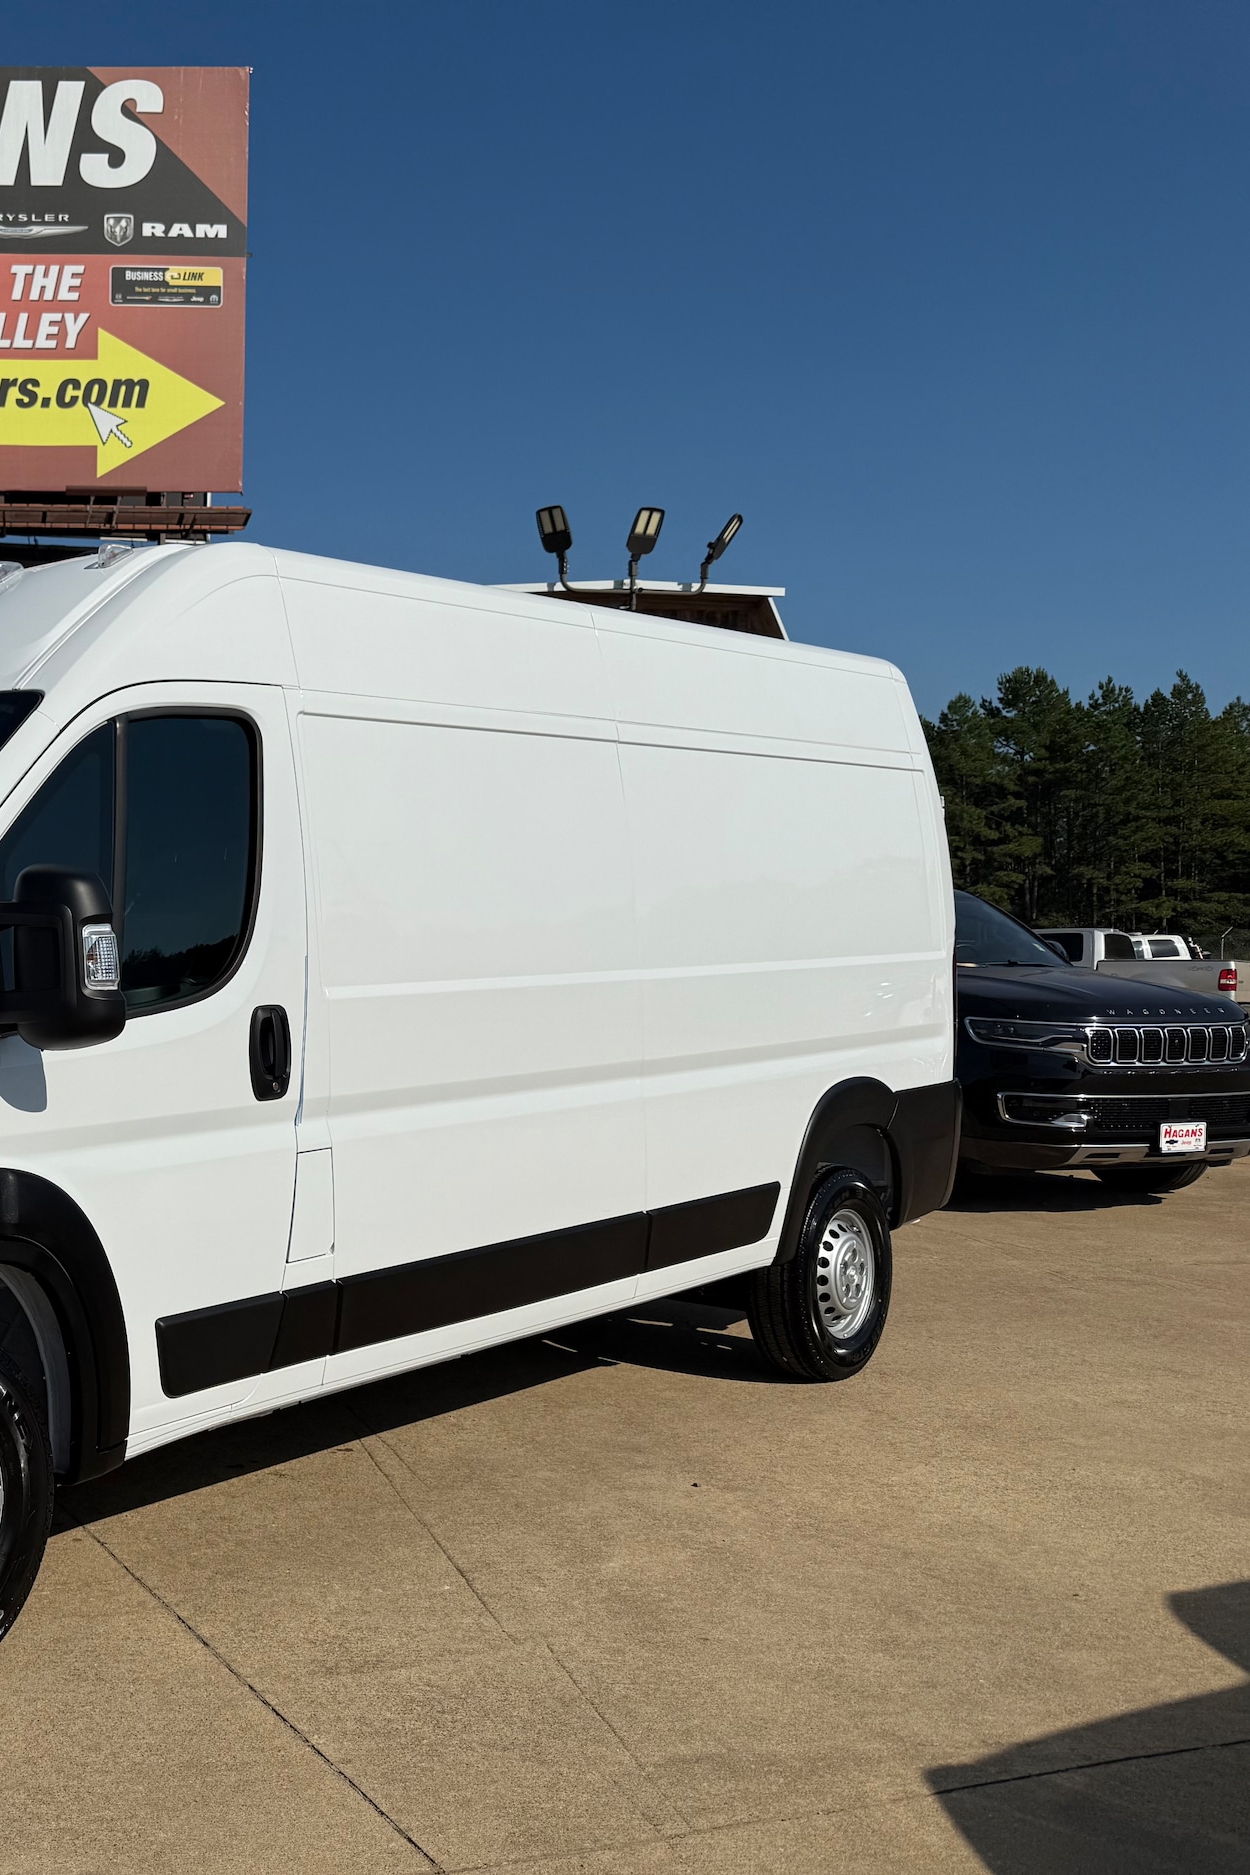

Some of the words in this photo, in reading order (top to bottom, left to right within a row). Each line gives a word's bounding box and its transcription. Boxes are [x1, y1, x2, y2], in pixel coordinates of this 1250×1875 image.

[141, 222, 228, 239] RAM
[125, 270, 164, 281] BUSINESS
[182, 271, 204, 281] LINK
[10, 265, 85, 302] THE
[1164, 1127, 1203, 1138] HAGANS
